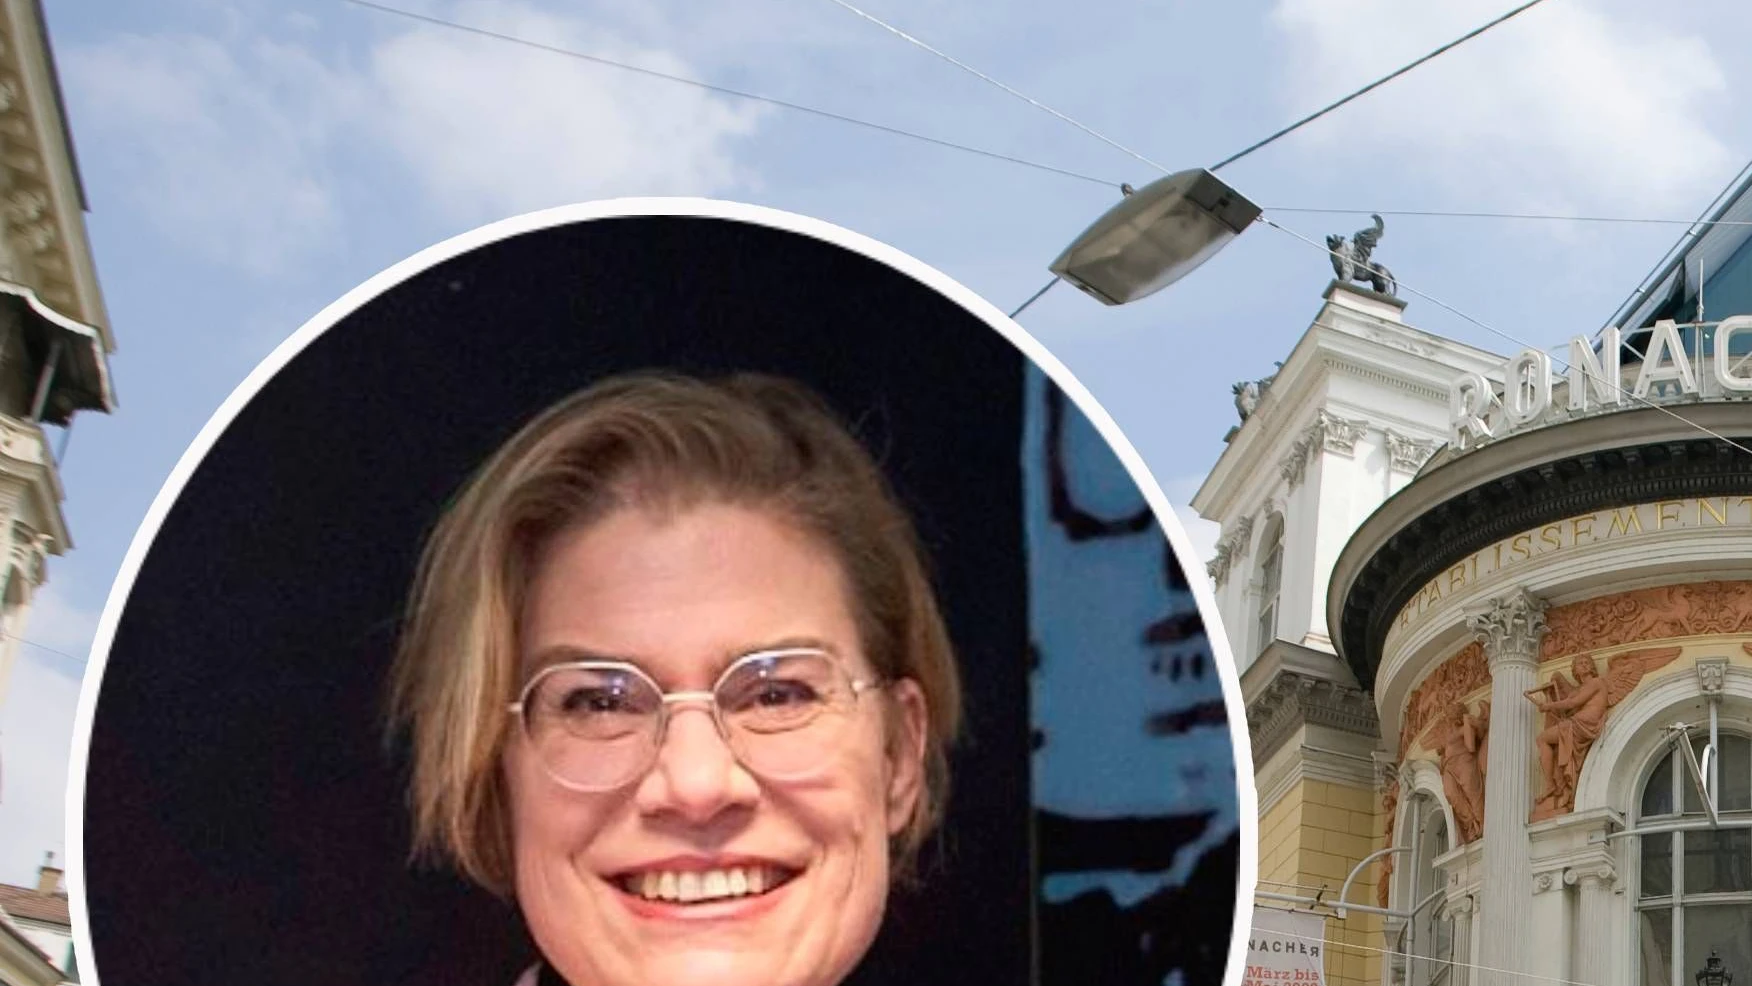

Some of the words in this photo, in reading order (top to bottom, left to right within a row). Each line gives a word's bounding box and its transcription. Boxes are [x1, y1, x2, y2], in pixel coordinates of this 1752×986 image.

[1248, 940, 1319, 957] NACHER
[1246, 966, 1290, 980] März
[1295, 969, 1319, 981] bis
